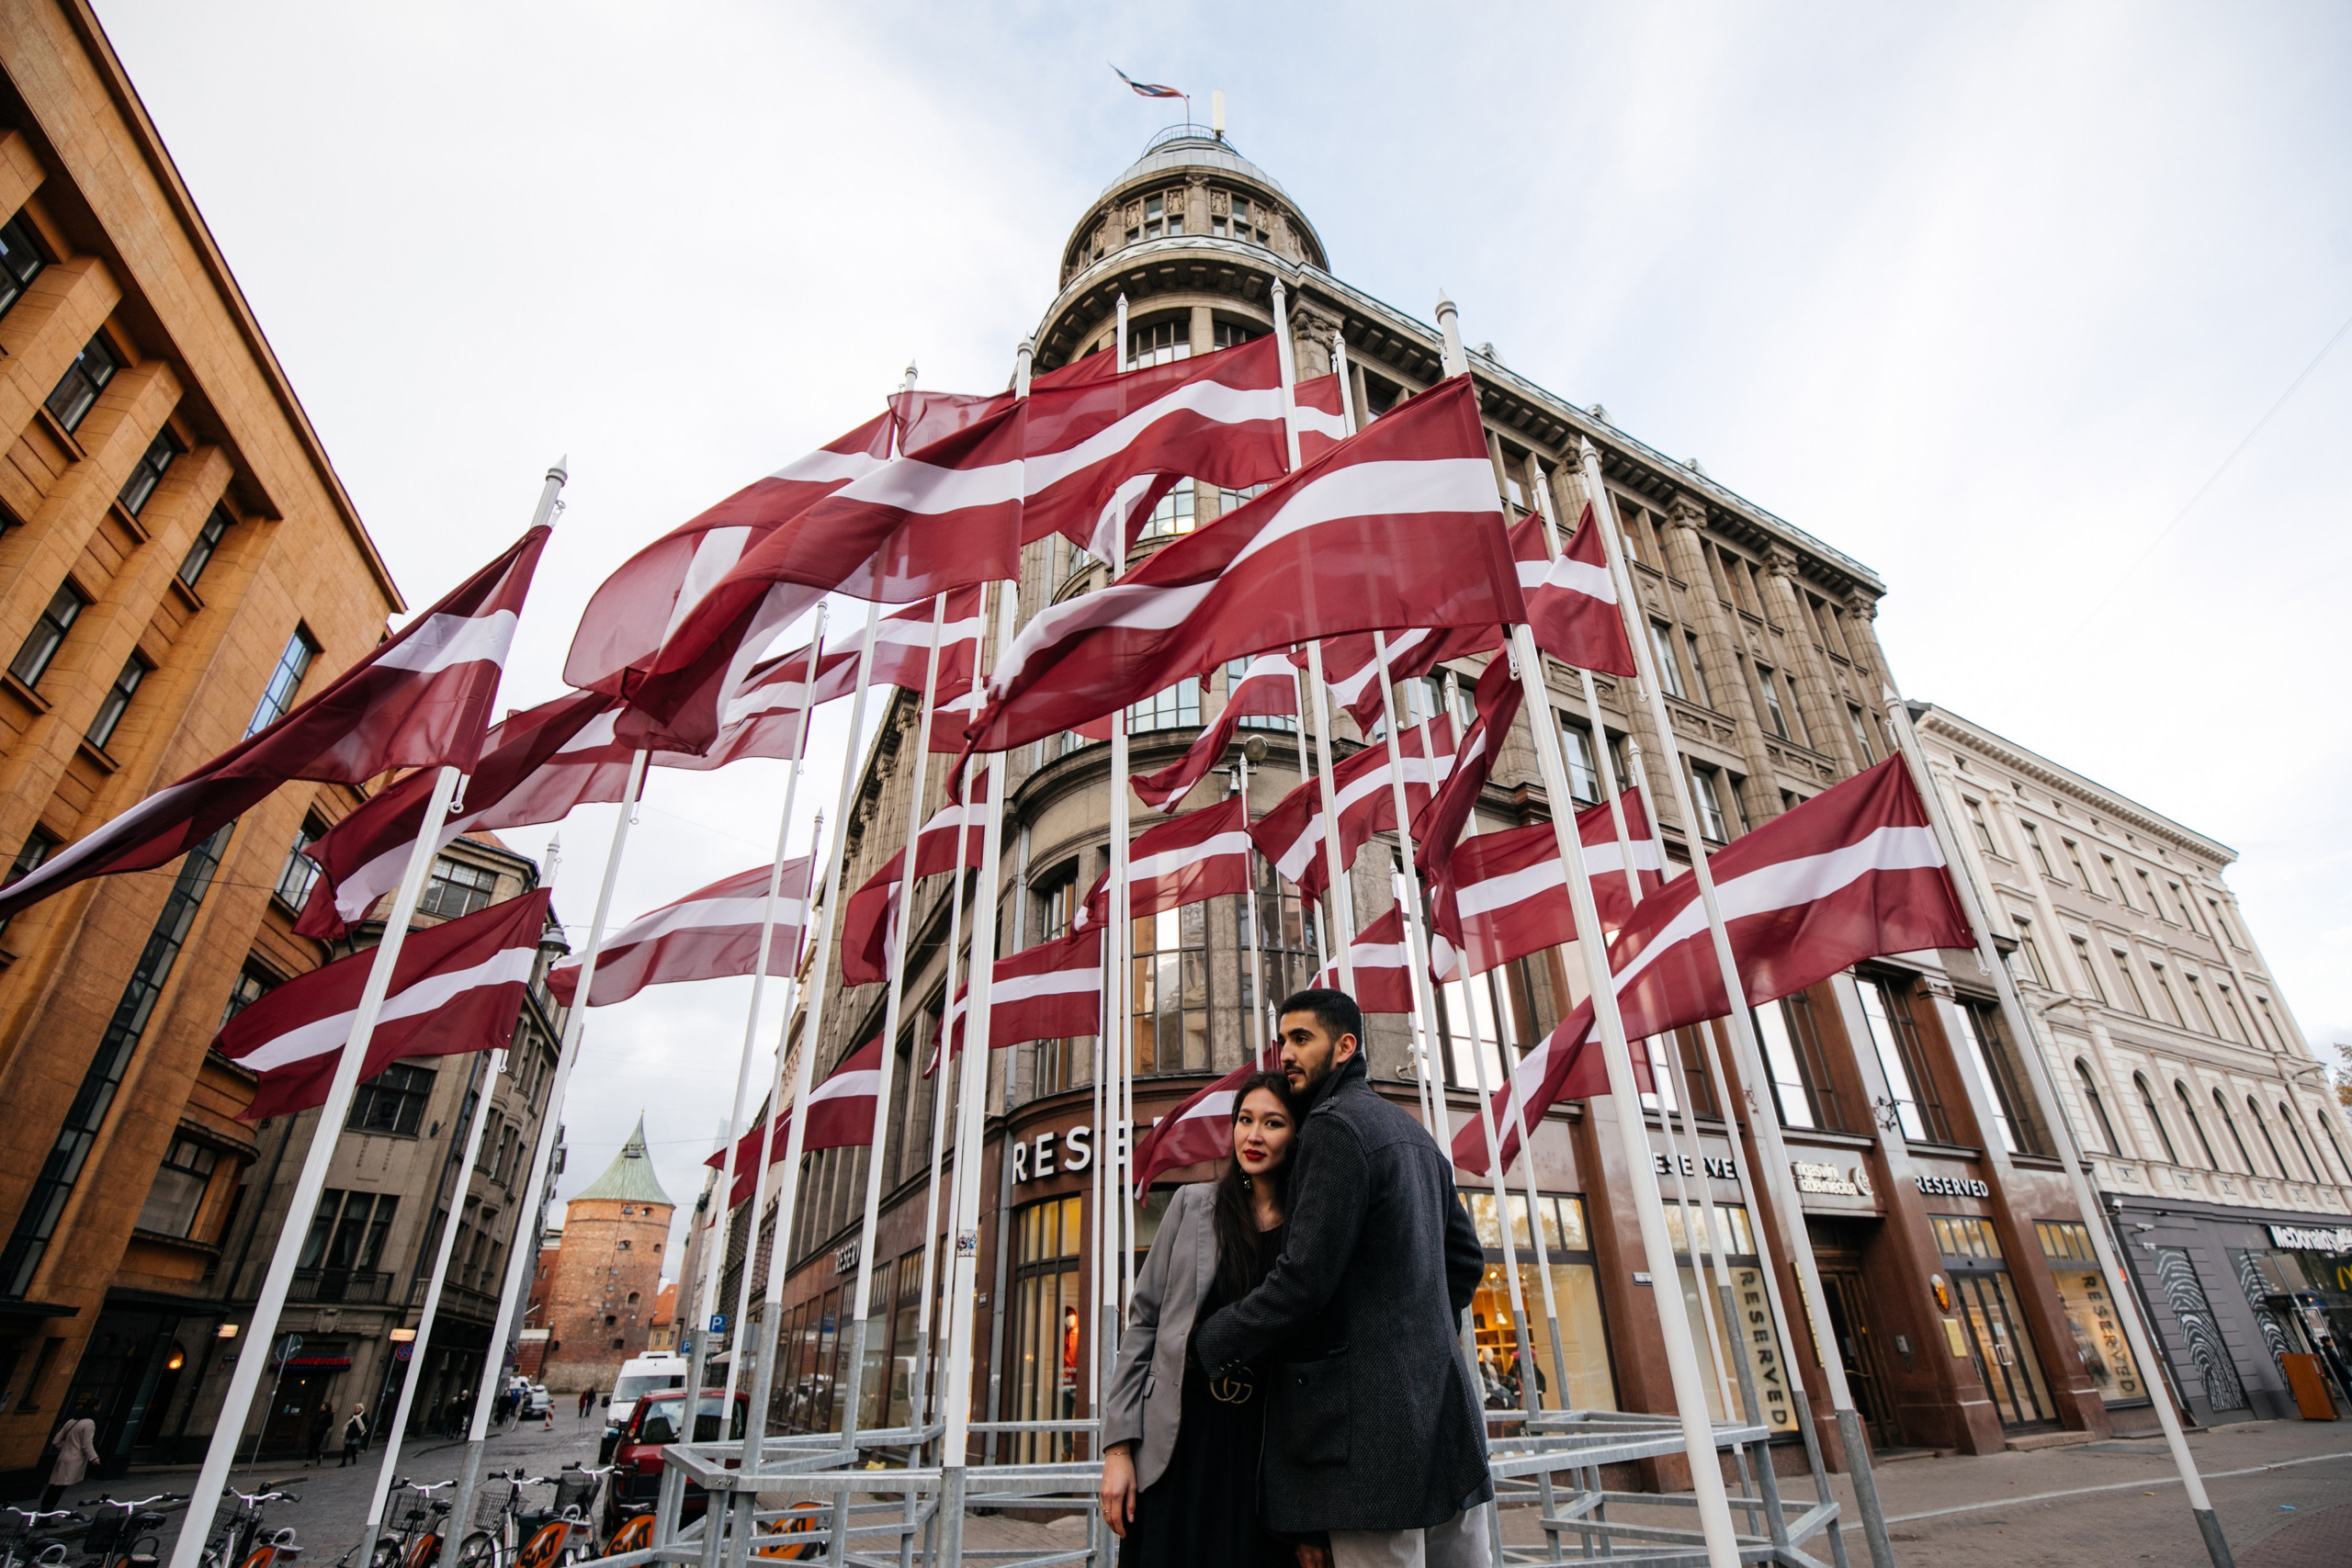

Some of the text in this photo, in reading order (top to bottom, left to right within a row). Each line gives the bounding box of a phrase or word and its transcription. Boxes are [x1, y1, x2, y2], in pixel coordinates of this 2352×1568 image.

[1915, 1175, 1988, 1197] RESERVED
[834, 1236, 862, 1275] RESERV
[711, 1316, 723, 1330] P
[2082, 1276, 2135, 1393] RESERVED
[683, 1341, 691, 1351] P
[1739, 1271, 1788, 1425] RESERVED
